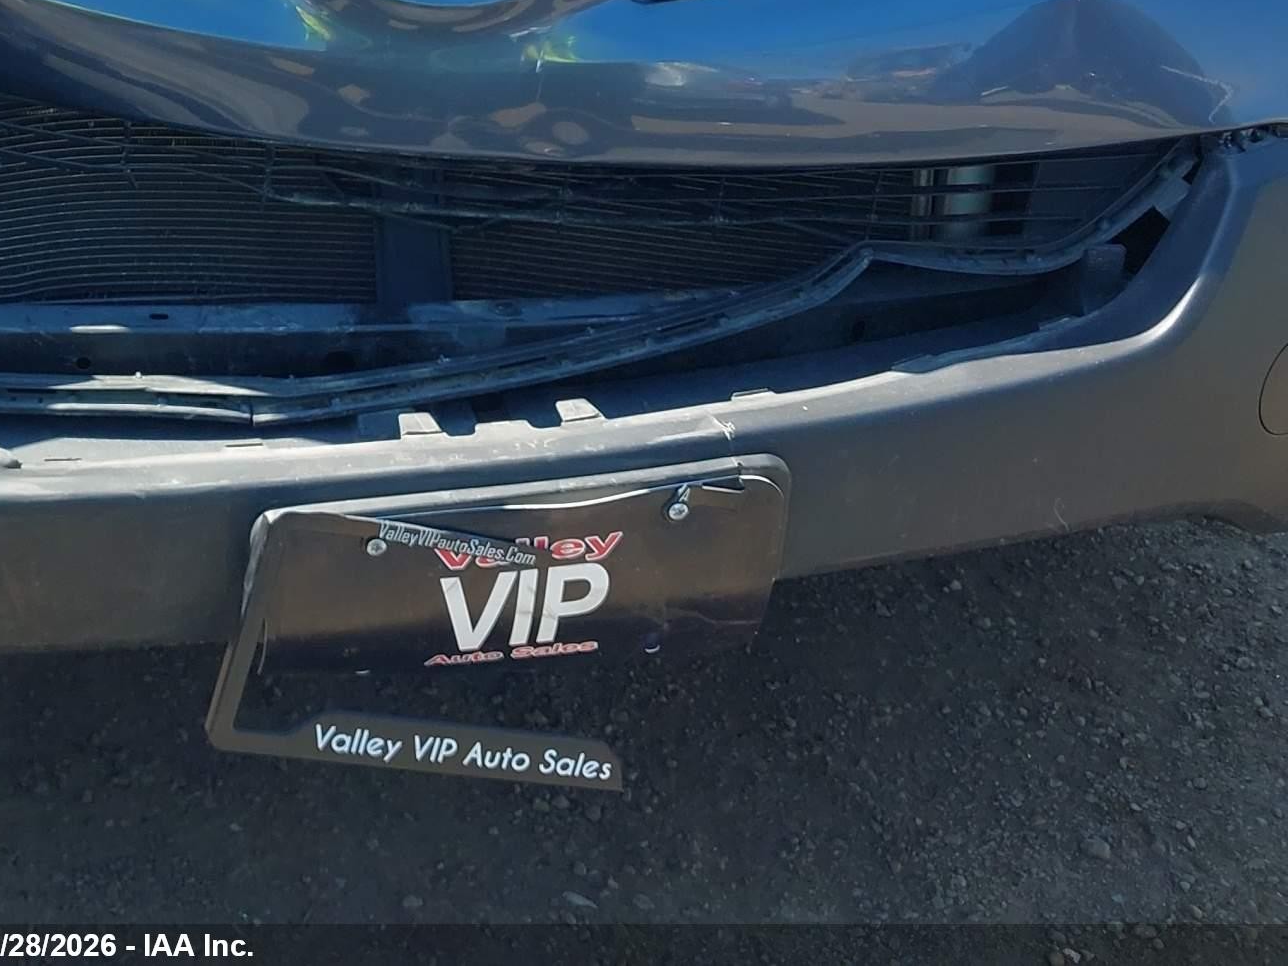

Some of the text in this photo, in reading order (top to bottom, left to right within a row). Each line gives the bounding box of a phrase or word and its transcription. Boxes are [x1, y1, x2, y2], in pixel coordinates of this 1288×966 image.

[378, 521, 537, 565] ValleyVIPautoSales.Com
[439, 562, 609, 652] VIP
[424, 640, 599, 667] Auto Sales
[315, 723, 612, 780] Valley VIP Auto Sales
